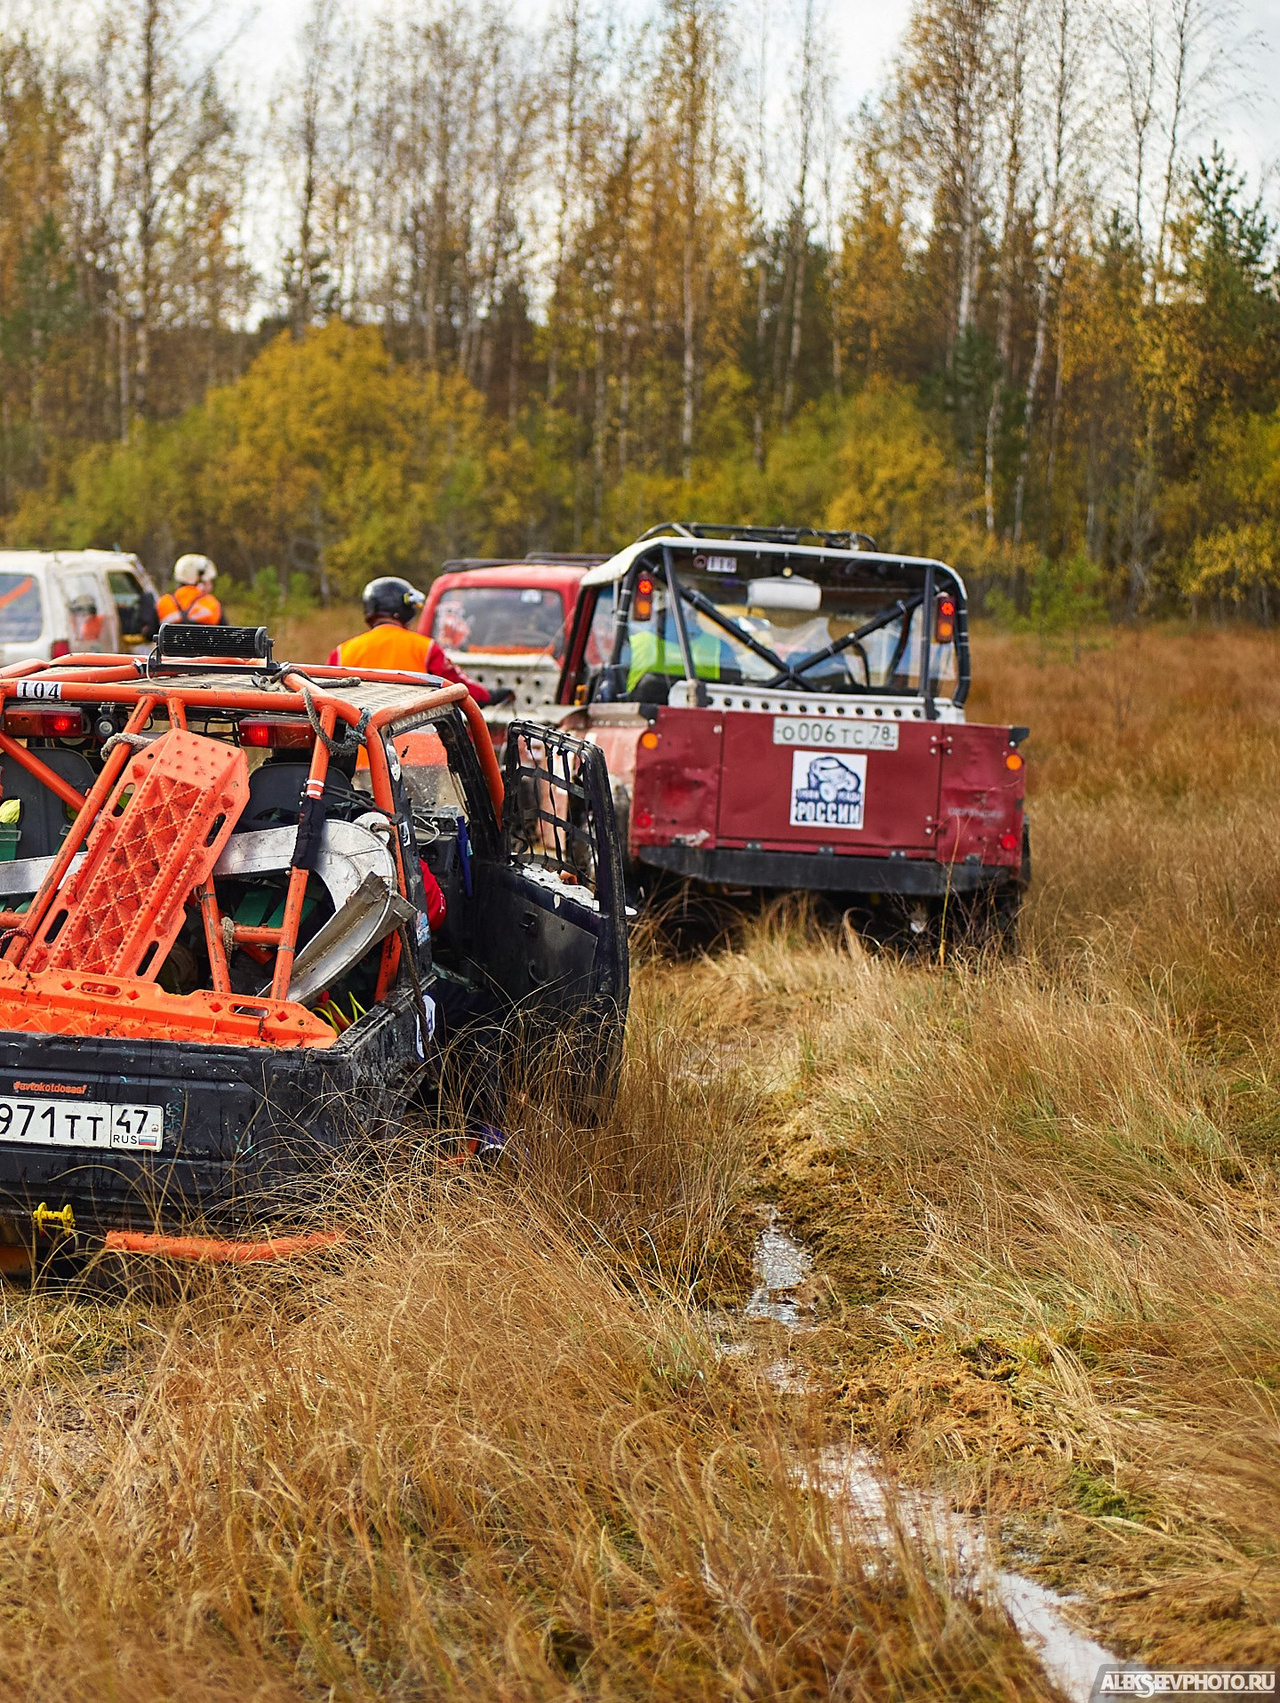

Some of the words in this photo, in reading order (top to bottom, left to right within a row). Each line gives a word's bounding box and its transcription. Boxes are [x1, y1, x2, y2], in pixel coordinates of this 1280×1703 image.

[21, 682, 60, 699] 104
[872, 725, 890, 741] 78
[797, 801, 860, 823] РОССИИ
[13, 1081, 87, 1095] #avtokotdosaaf
[115, 1109, 149, 1134] 47
[112, 1134, 137, 1146] RUS
